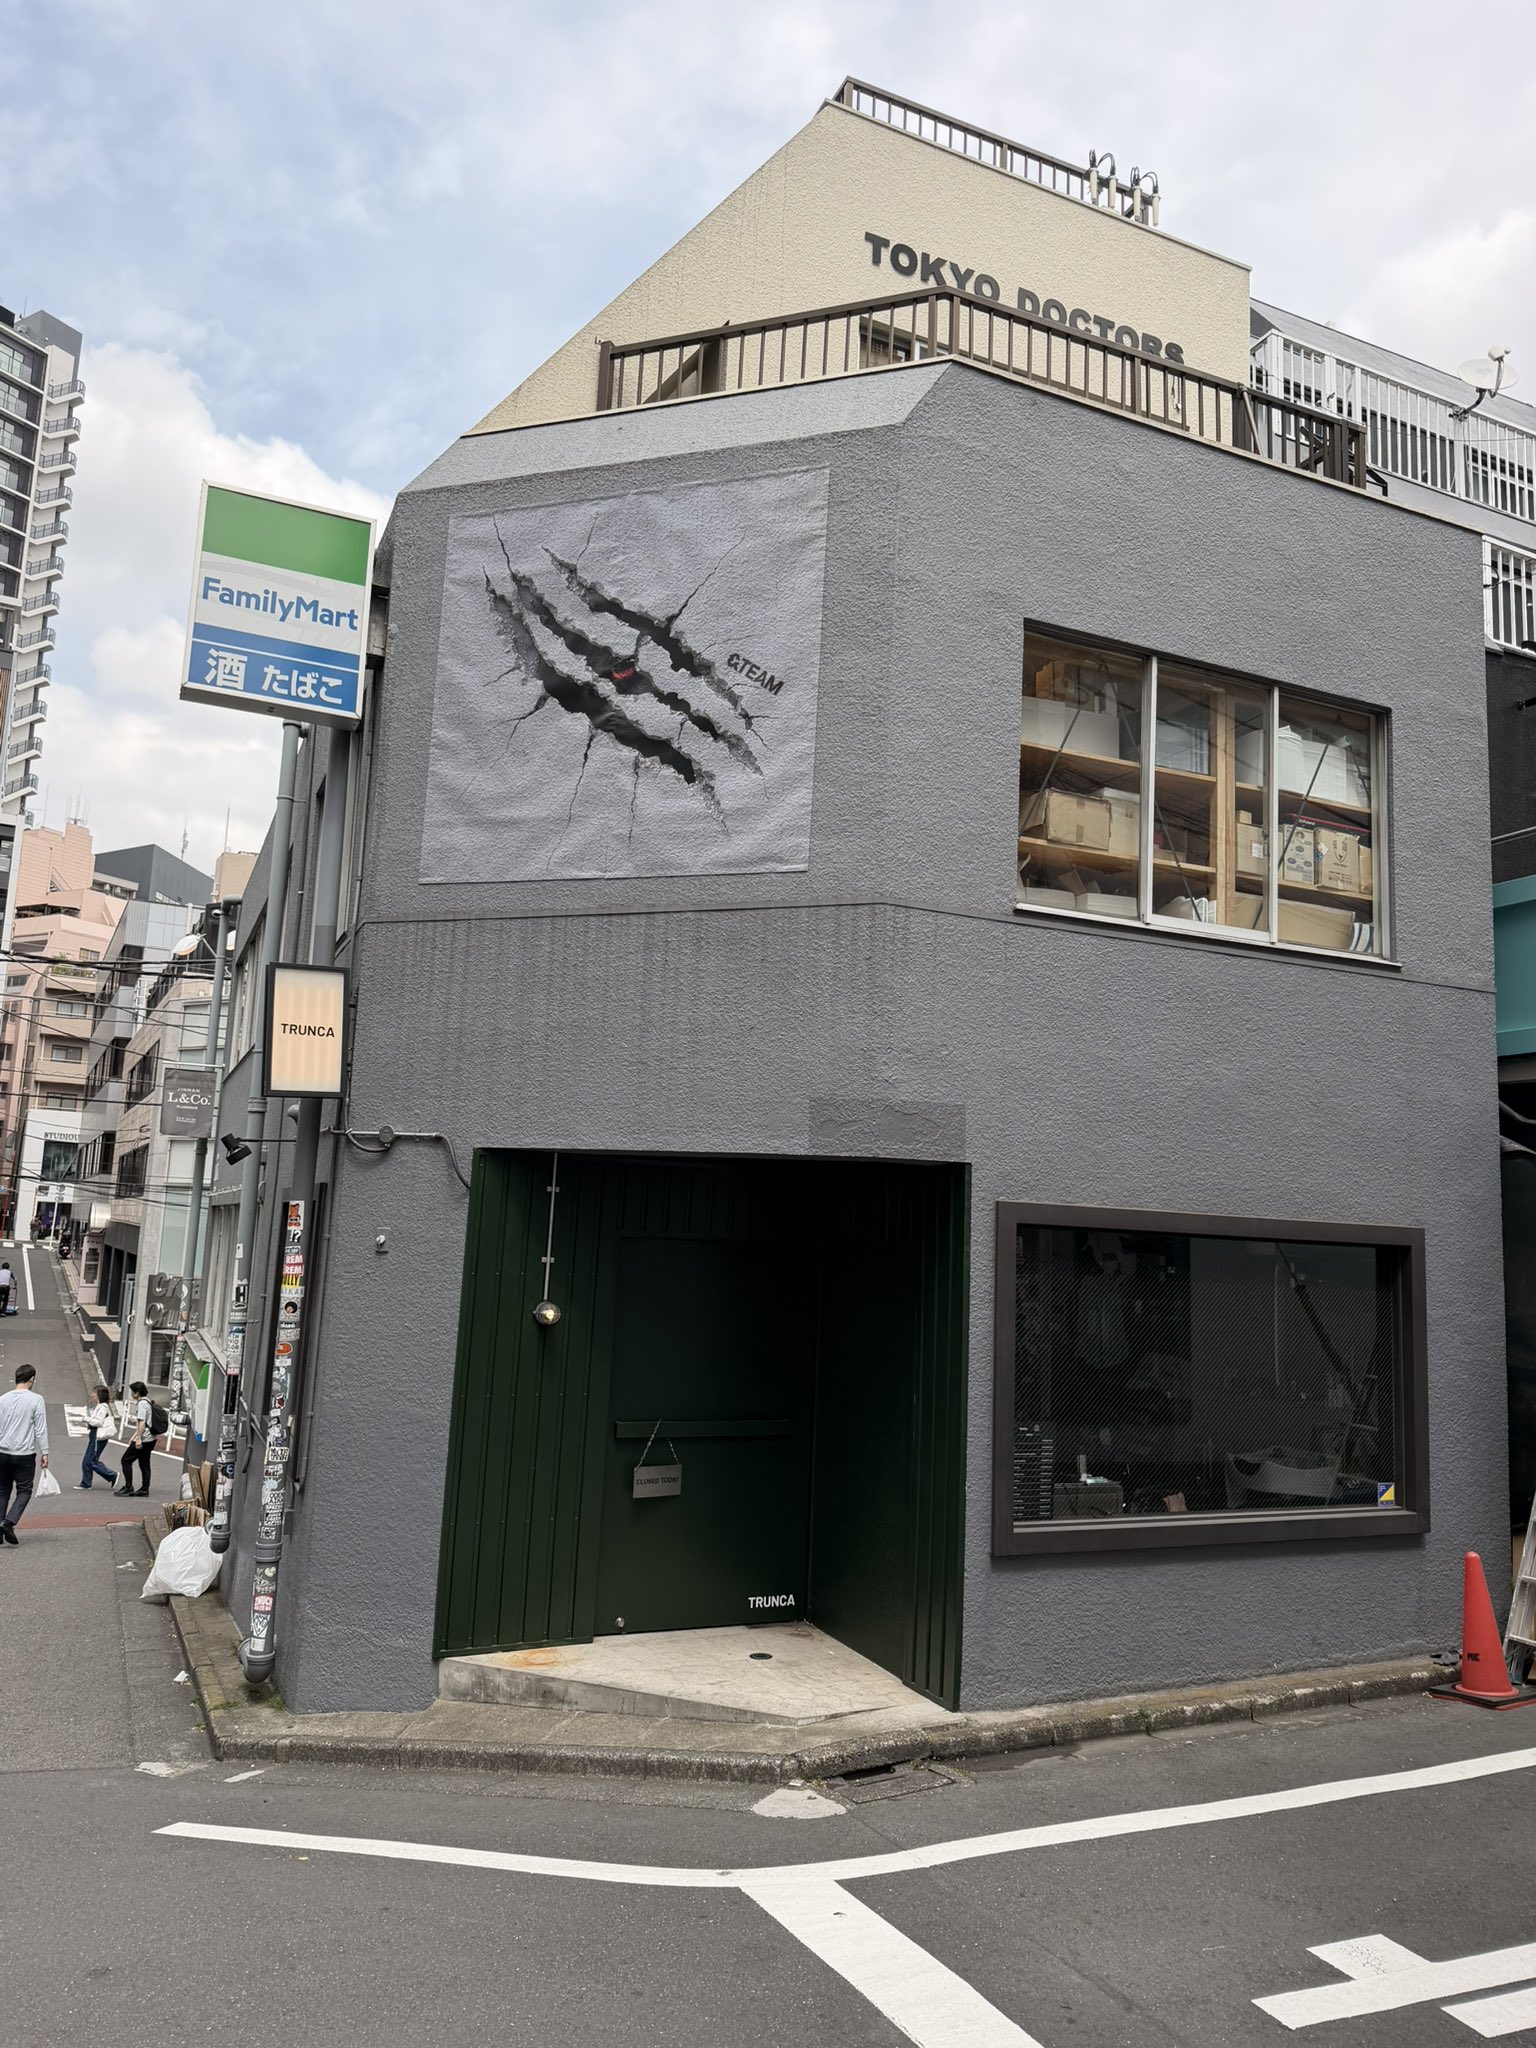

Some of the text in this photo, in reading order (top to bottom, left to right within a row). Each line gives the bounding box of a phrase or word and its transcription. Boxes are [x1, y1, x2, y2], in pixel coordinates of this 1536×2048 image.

[865, 231, 1185, 365] TOKYO DOCTORS
[202, 576, 359, 631] FamilyMart
[204, 648, 342, 704] 酒 たばこ
[281, 1023, 335, 1038] TRUNCA
[748, 1594, 796, 1609] TRUNCA
